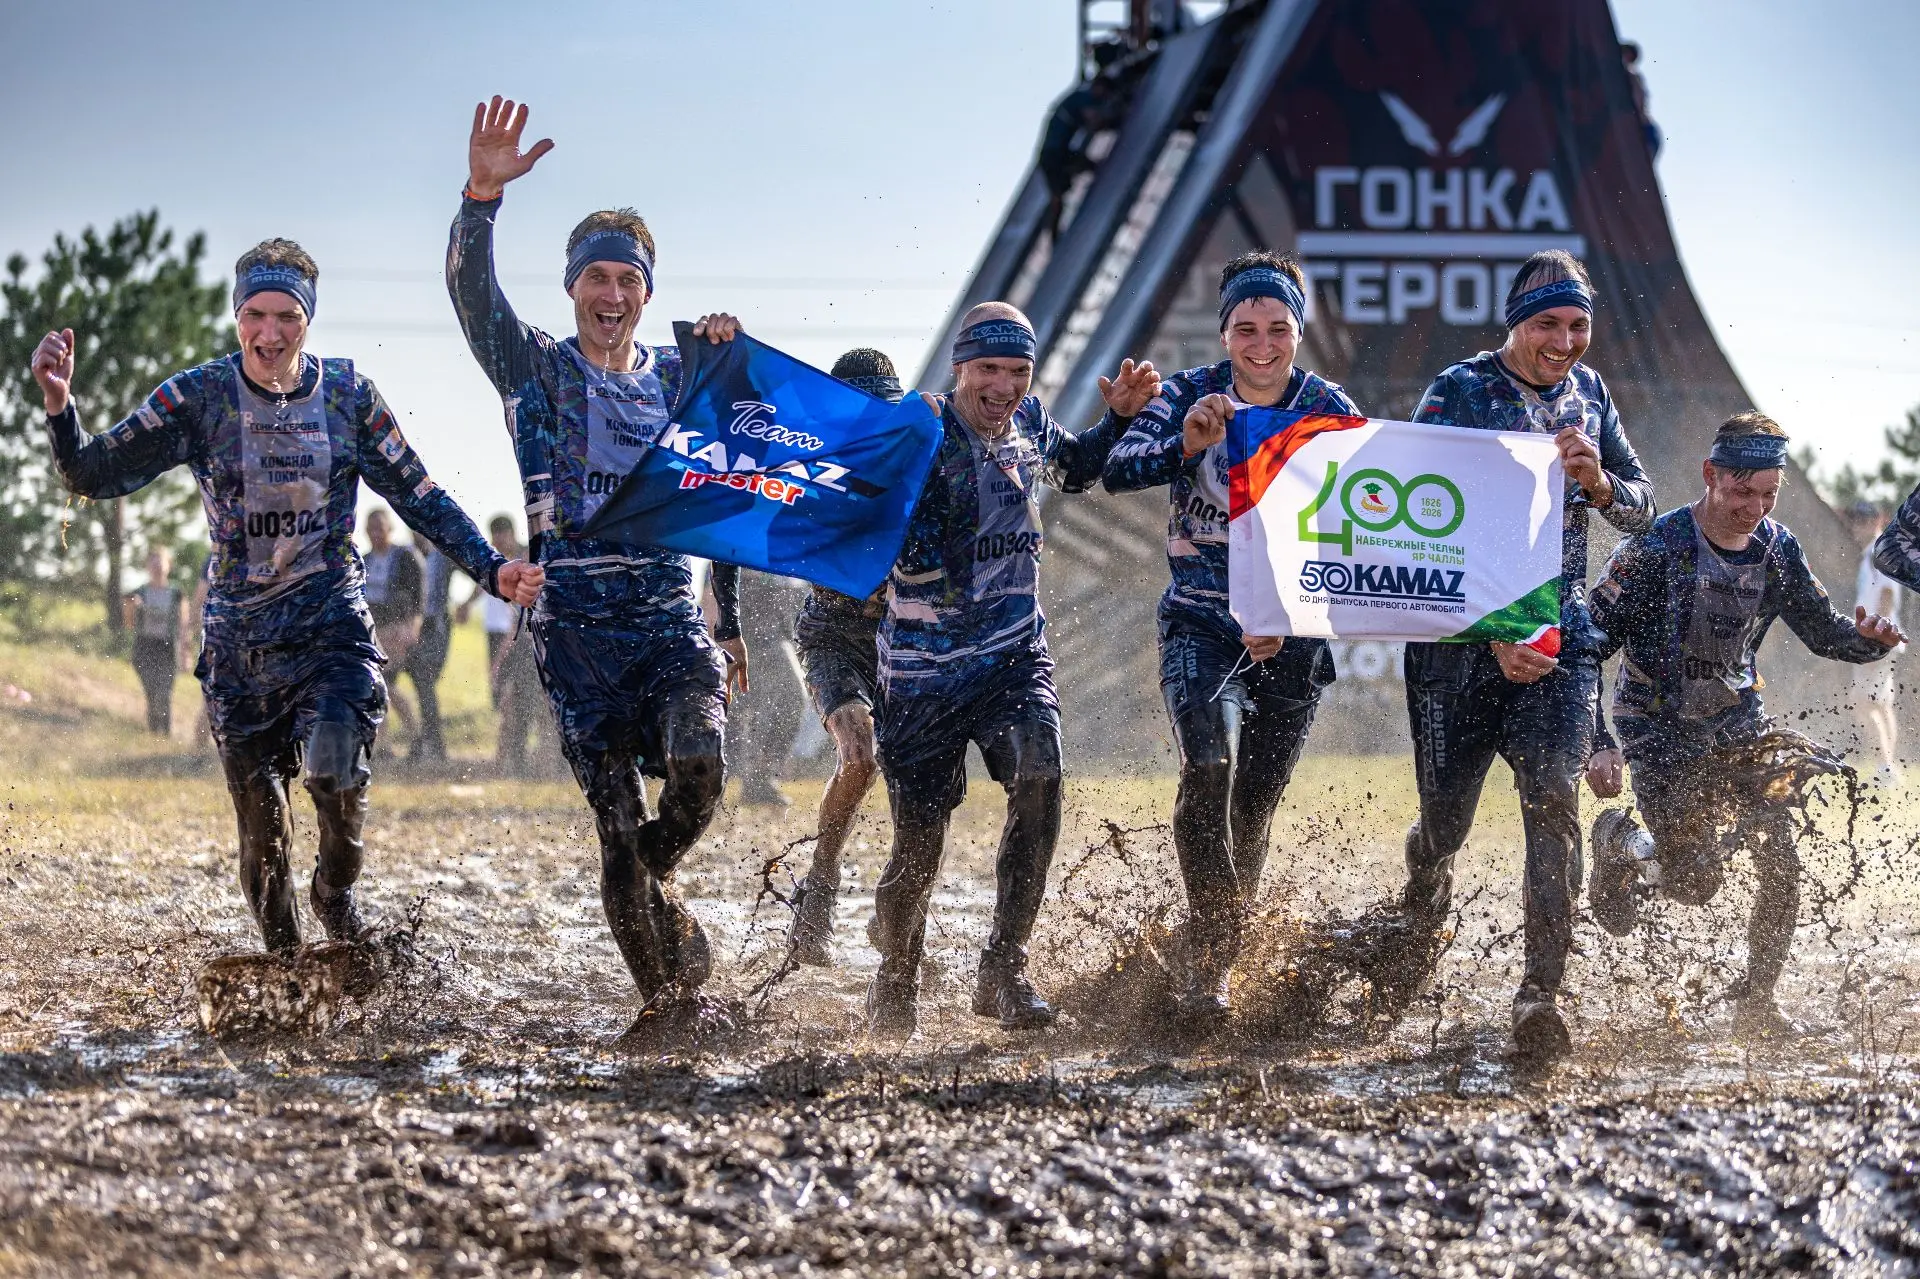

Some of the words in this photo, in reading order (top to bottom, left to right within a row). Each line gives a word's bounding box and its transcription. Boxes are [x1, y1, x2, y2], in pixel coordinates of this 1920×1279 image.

[1314, 165, 1571, 230] ГОНКА
[589, 231, 635, 244] maste
[1299, 262, 1514, 327] ГЕРО
[250, 422, 280, 432] ГОНКА
[284, 421, 320, 431] ГЕРОЕВ
[605, 418, 656, 438] КОМАНДА
[729, 401, 825, 451] Team
[260, 454, 315, 468] КОМАНДА
[658, 422, 852, 493] KAMAZ
[587, 471, 627, 495] 00
[679, 468, 806, 506] master
[1298, 461, 1465, 556] 400
[1420, 497, 1442, 507] 1626
[1420, 507, 1442, 518] 2026
[1355, 534, 1426, 551] НАБЕРЕЖНЫЕ
[1429, 541, 1465, 556] ЧЕЛНЫ
[1411, 553, 1425, 563] ЯР
[1428, 554, 1465, 566] ЧАЛЛЫ
[1299, 560, 1351, 595] 50
[1354, 563, 1466, 598] KAMAZ
[1299, 594, 1311, 603] СО
[1312, 595, 1328, 605] ДНЯ
[1330, 597, 1369, 608] ВЫПУСКА
[1370, 600, 1408, 612] ПЕРВОГО
[1409, 603, 1466, 614] АВТОМОБИЛЯ
[1432, 701, 1446, 768] master
